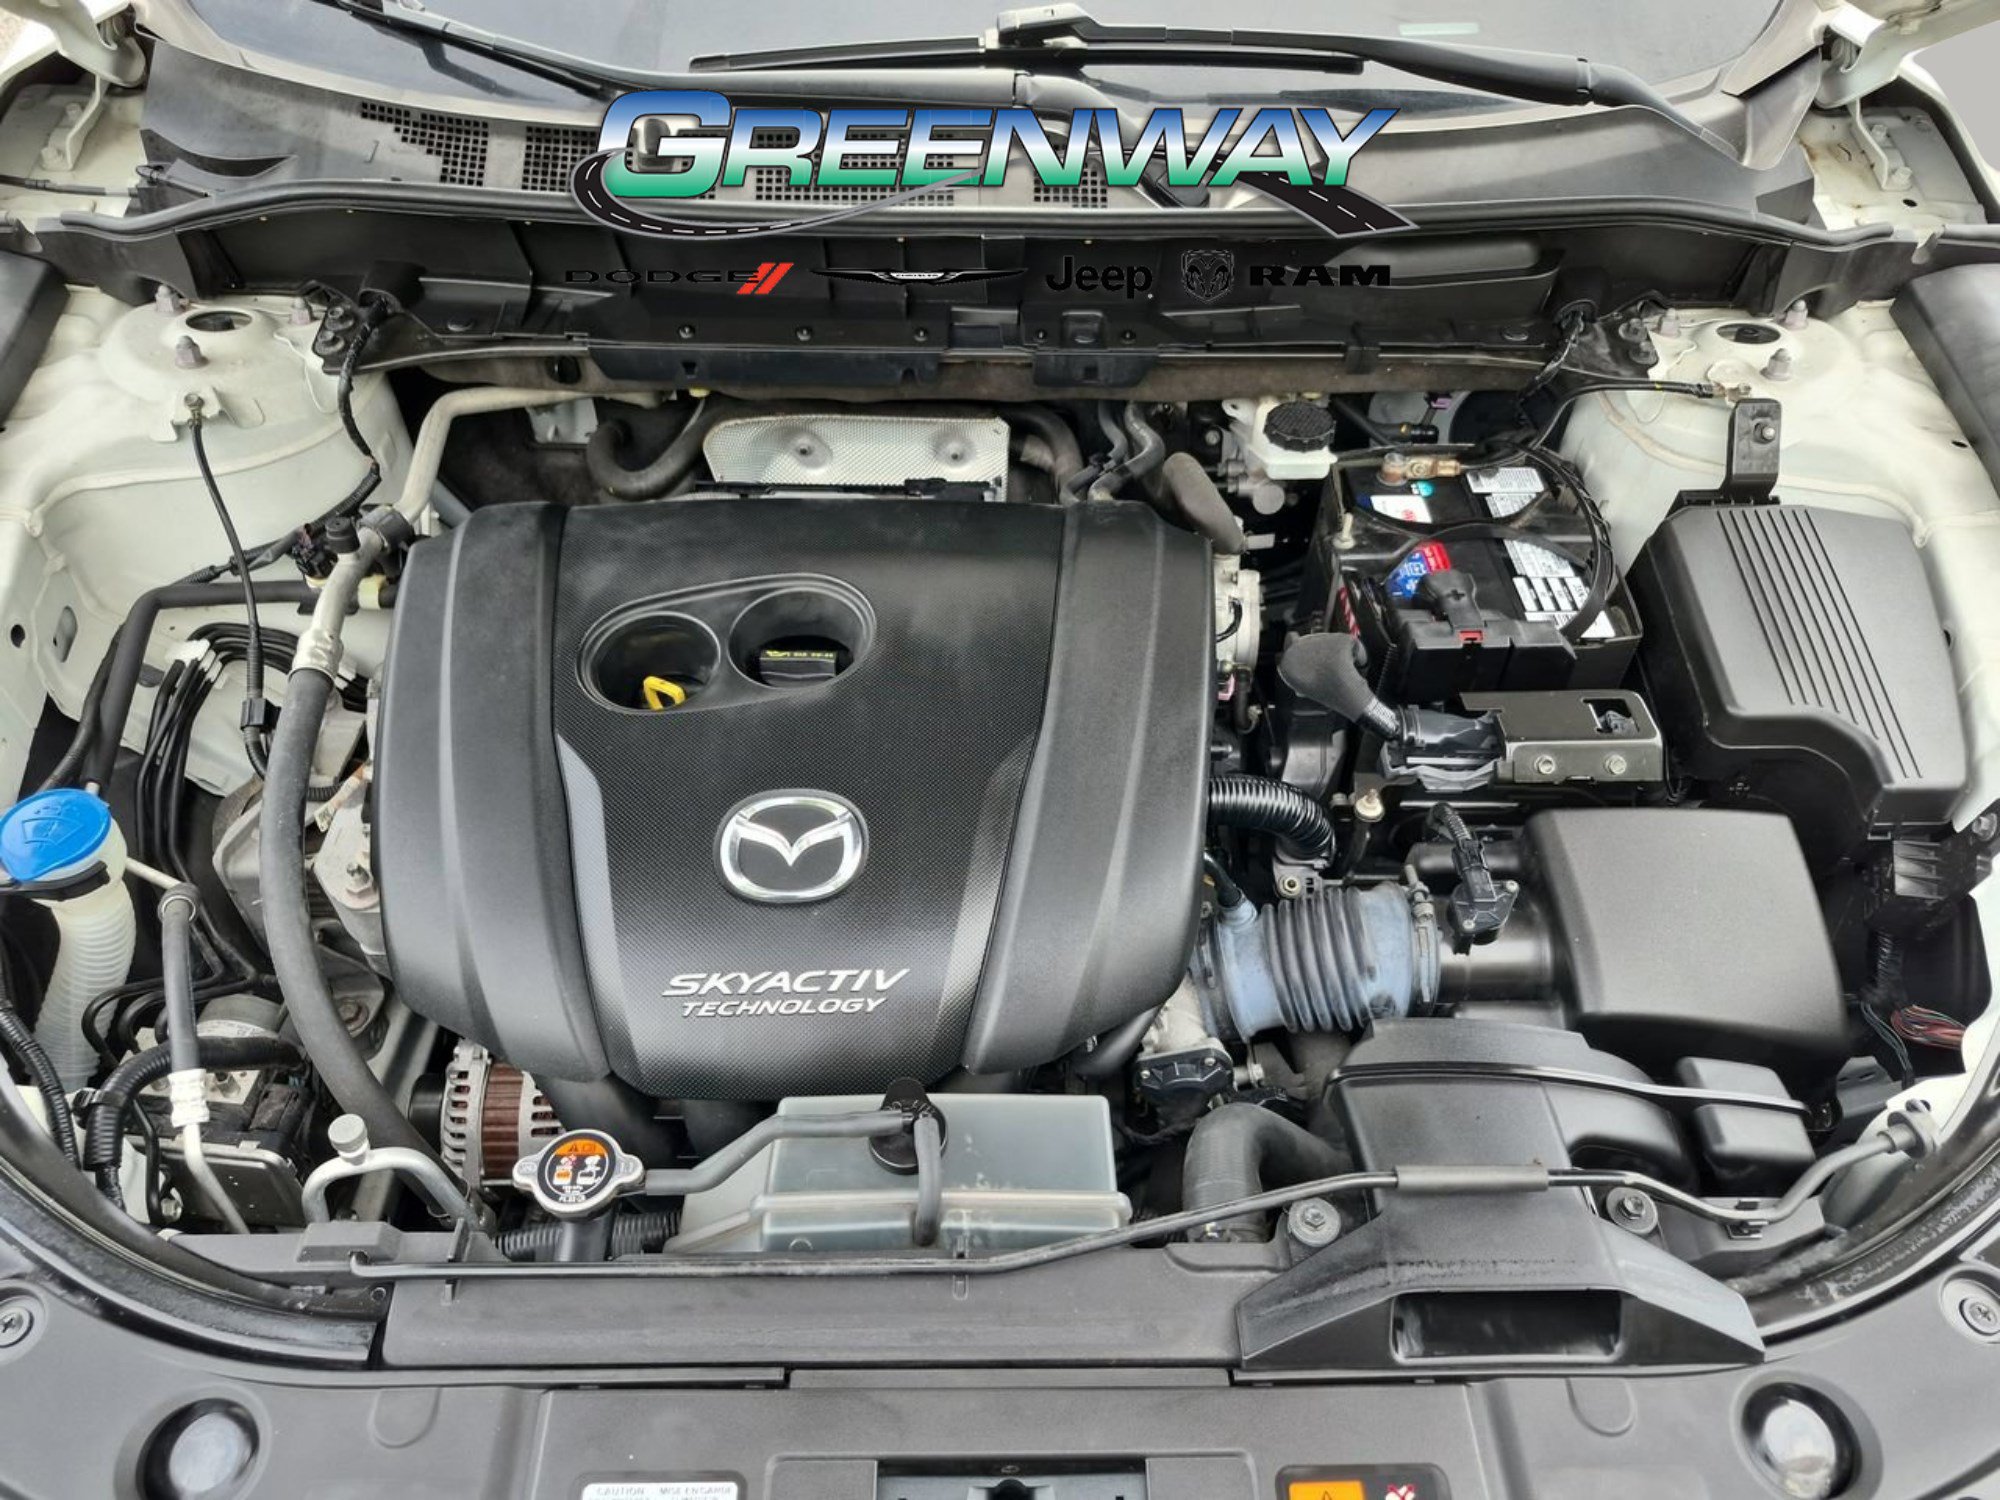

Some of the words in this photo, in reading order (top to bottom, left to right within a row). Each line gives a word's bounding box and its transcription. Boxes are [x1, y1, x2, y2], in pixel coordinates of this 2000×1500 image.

[662, 968, 910, 997] SKYACTIV
[682, 997, 886, 1018] TECHNOLOGY
[597, 1486, 645, 1496] CAUTION
